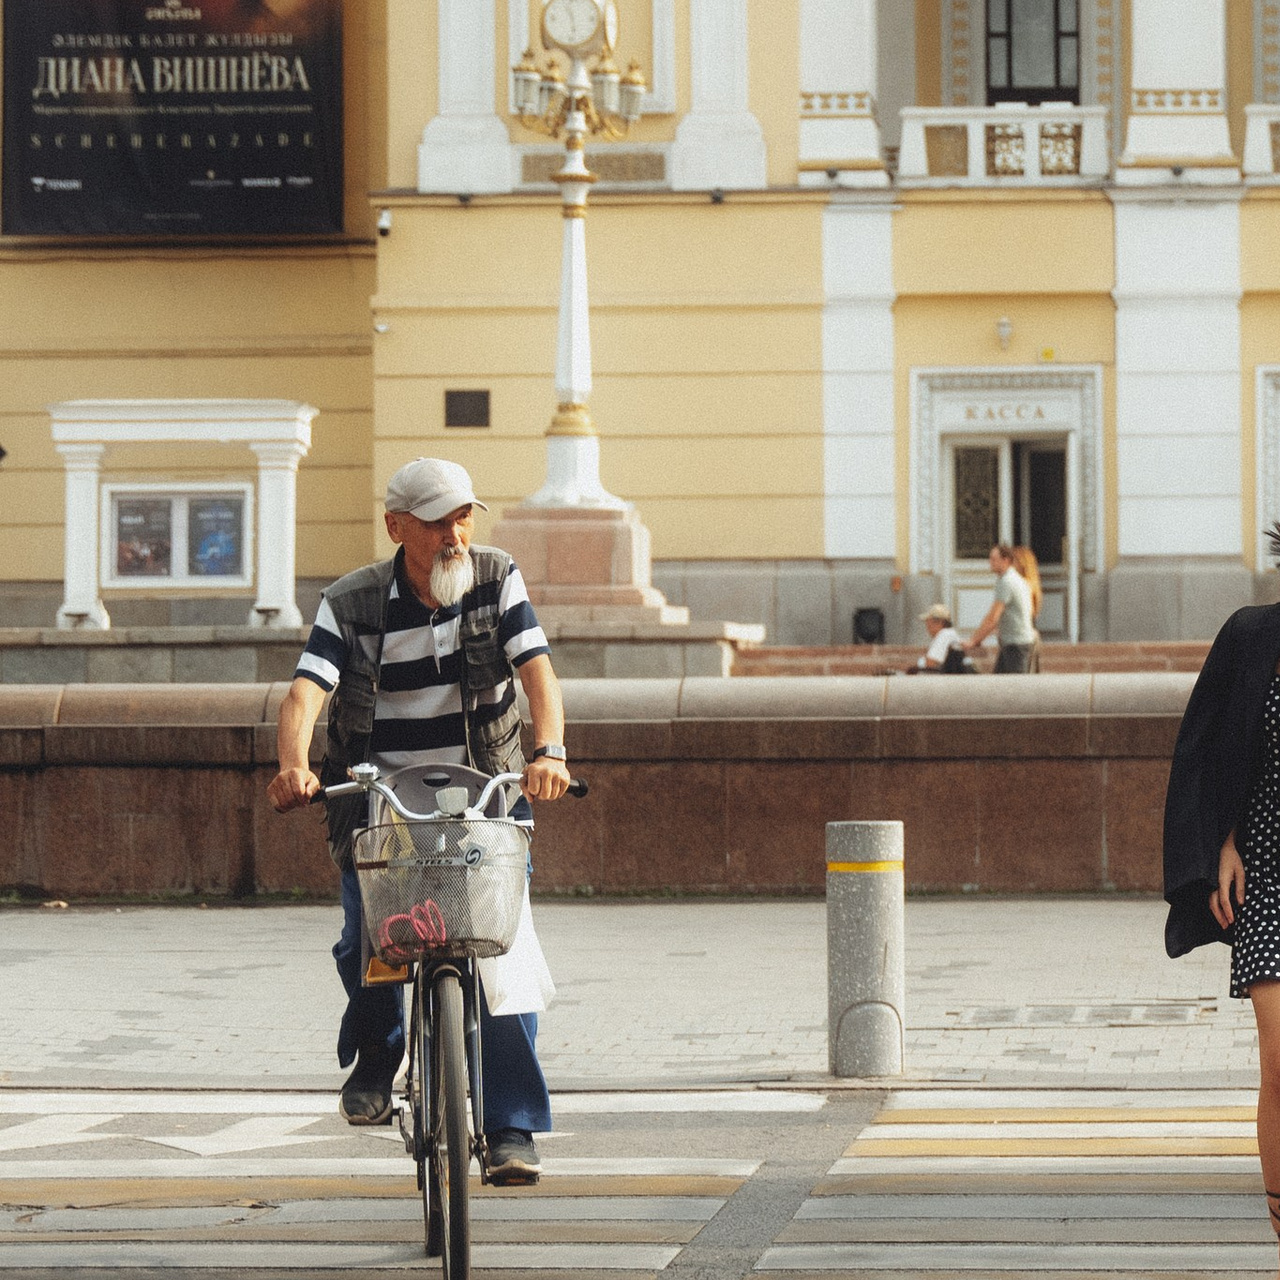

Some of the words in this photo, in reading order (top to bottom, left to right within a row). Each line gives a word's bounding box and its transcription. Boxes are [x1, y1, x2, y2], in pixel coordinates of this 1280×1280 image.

[33, 56, 146, 99] ДИАНА
[153, 51, 310, 93] ВИШНЁВА
[965, 404, 1045, 420] КАССА
